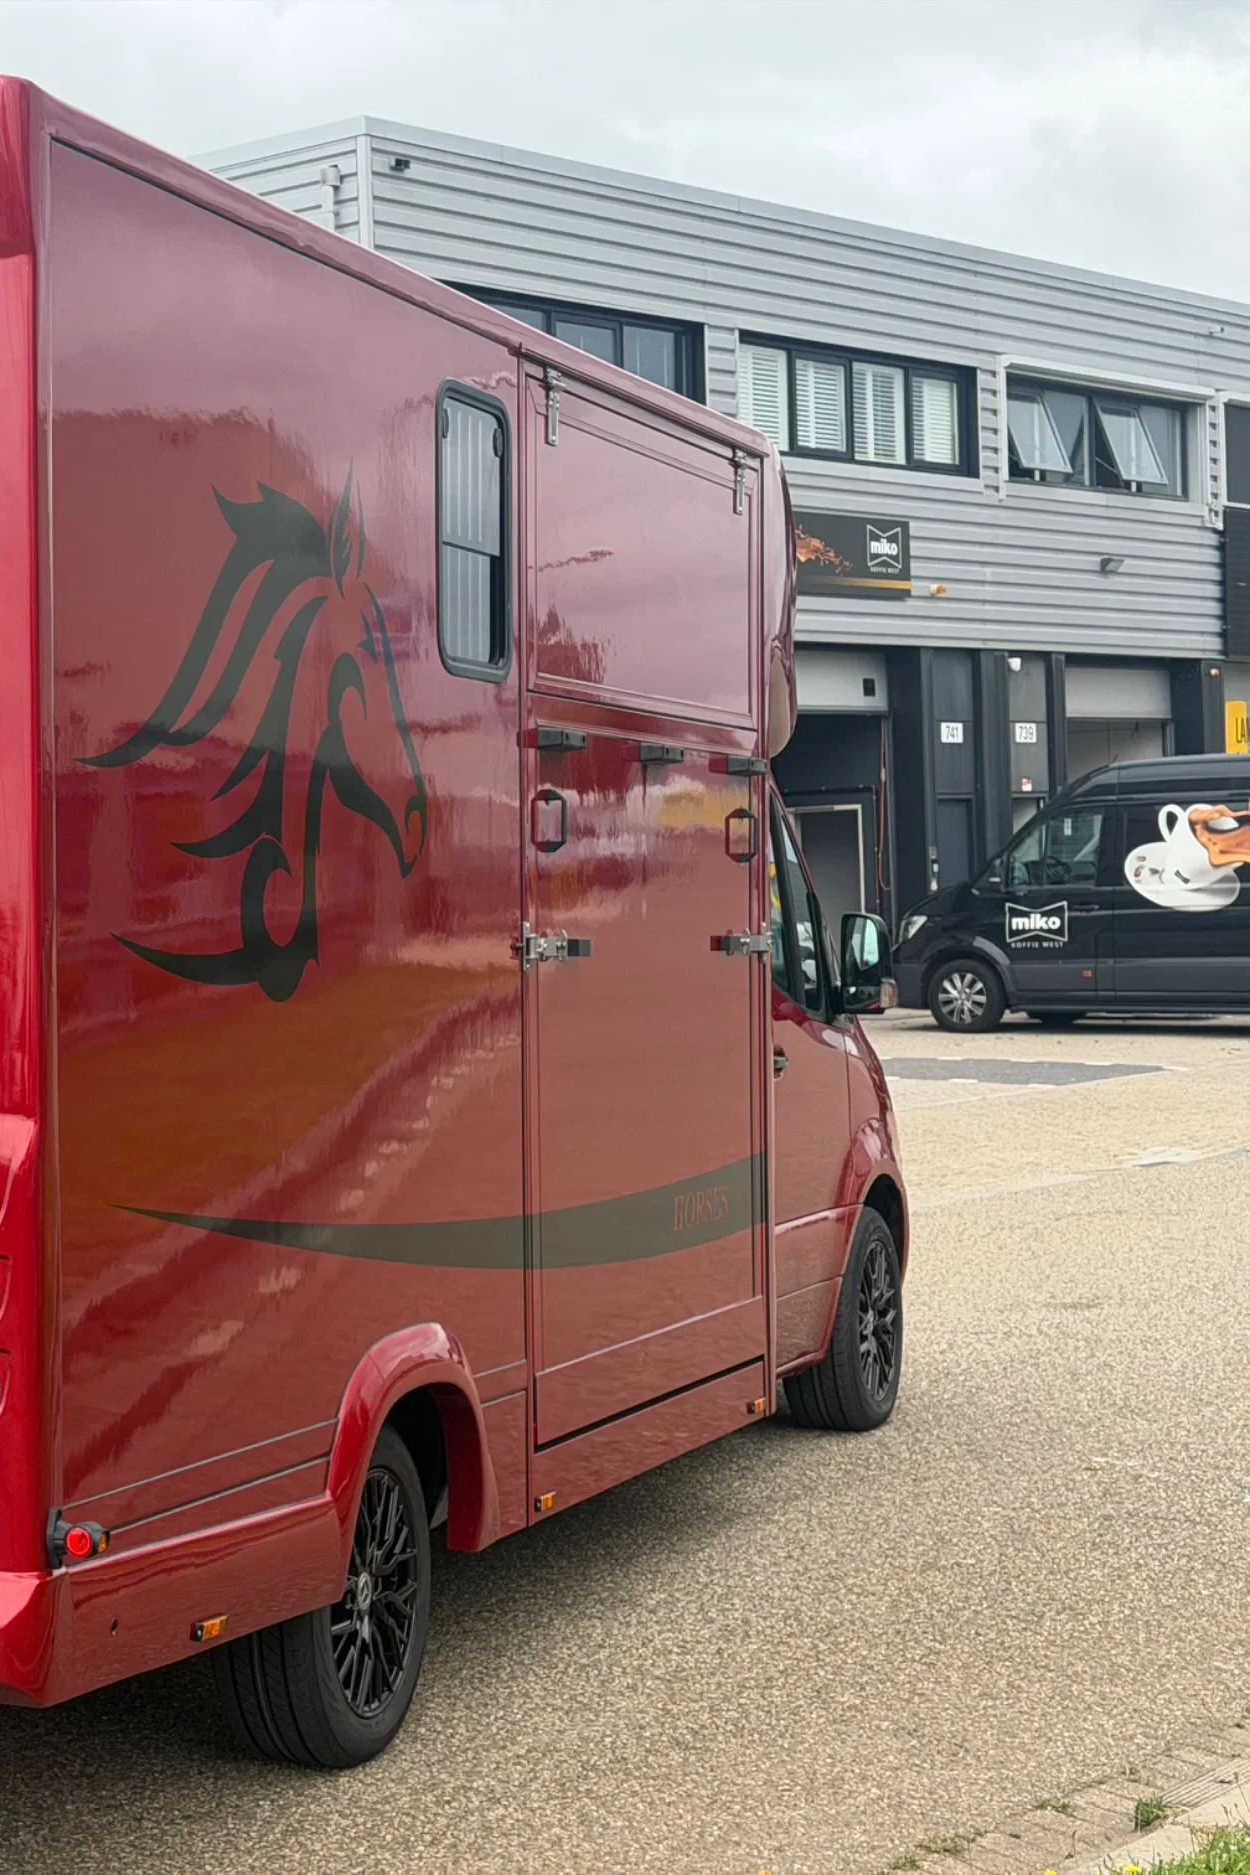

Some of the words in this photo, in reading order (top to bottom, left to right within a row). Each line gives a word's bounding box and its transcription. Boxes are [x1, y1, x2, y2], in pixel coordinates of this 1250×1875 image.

[870, 538, 899, 556] miko
[945, 725, 959, 741] 741
[1018, 725, 1034, 741] 739
[1011, 913, 1061, 931] miko
[673, 1185, 729, 1231] HORSES
